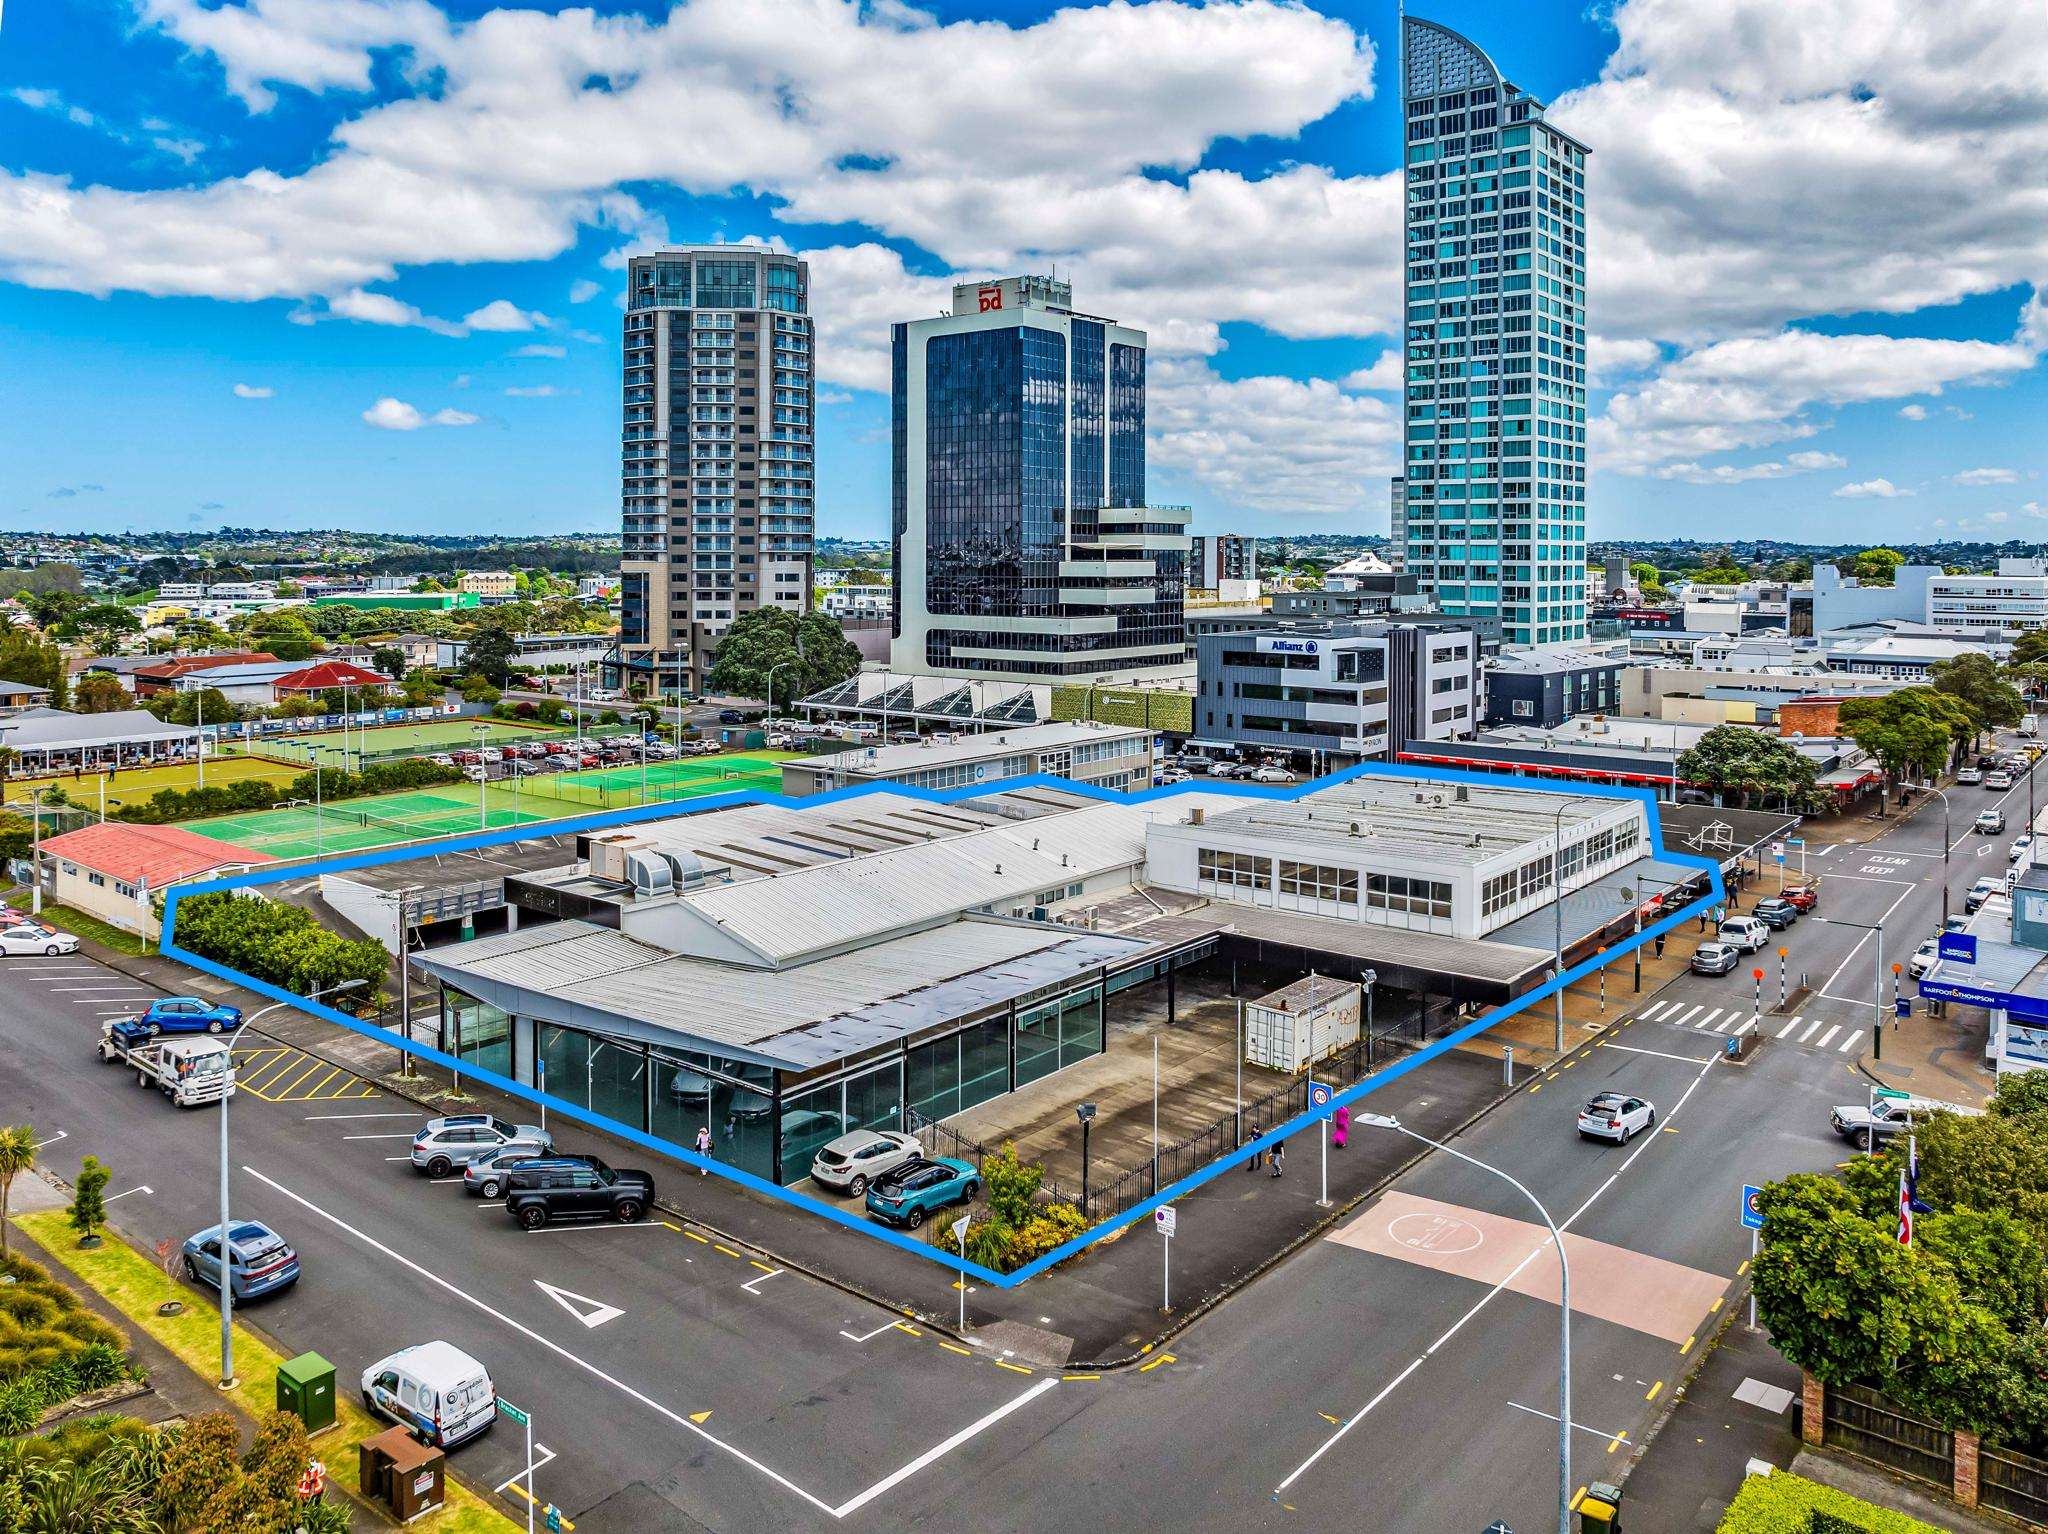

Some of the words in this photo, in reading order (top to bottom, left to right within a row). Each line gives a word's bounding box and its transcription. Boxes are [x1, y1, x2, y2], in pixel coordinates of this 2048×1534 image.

[1271, 641, 1303, 651] Allianz
[1868, 856, 1911, 865] CLEAR
[1859, 866, 1895, 874] KEEP
[1316, 1093, 1326, 1102] 30
